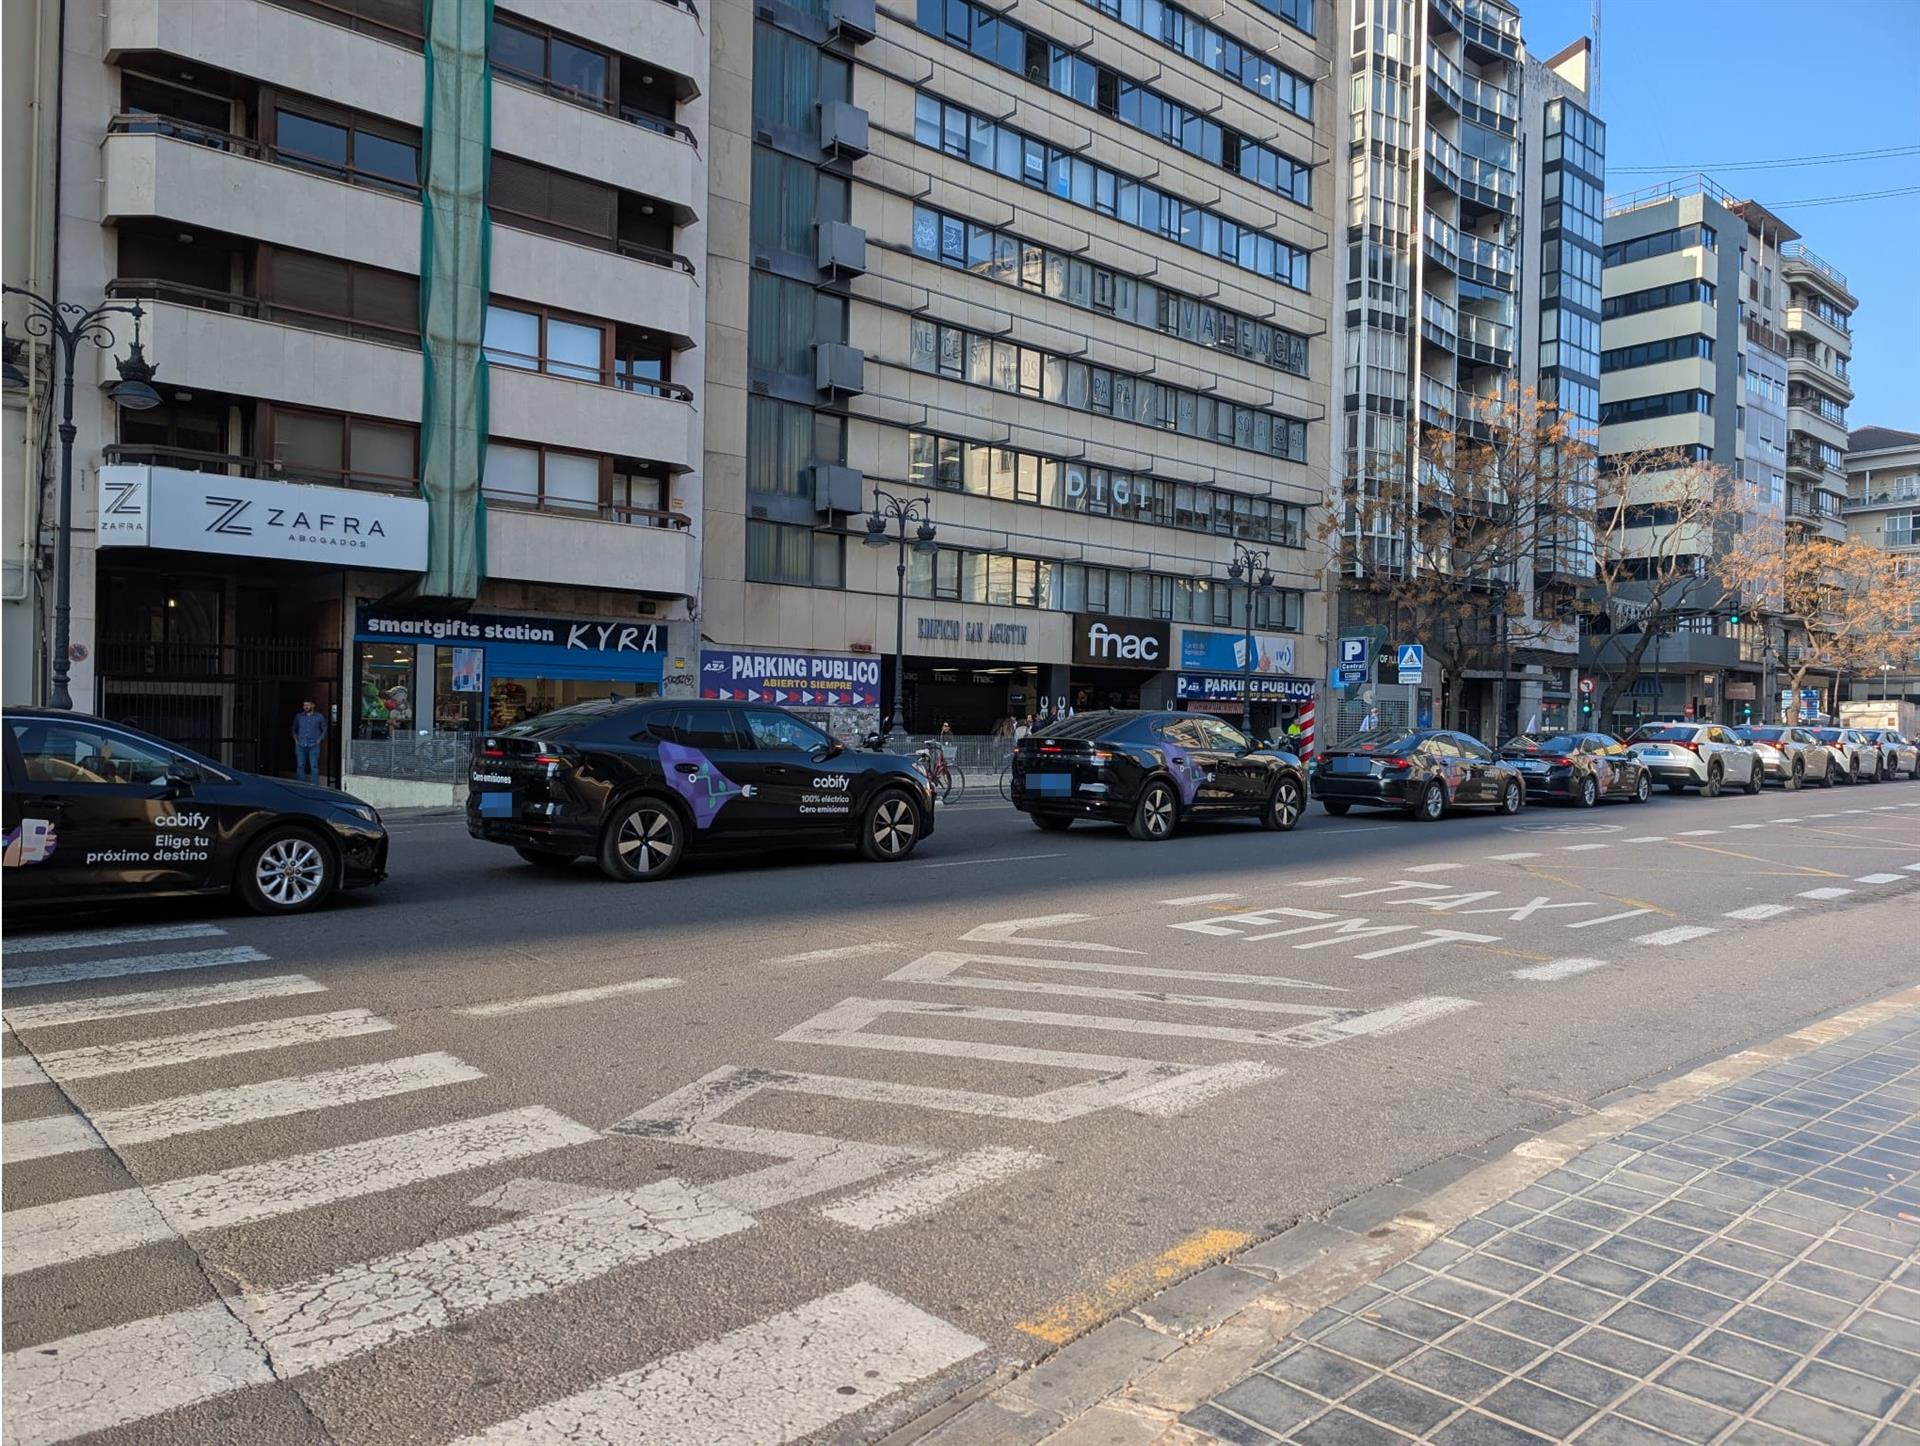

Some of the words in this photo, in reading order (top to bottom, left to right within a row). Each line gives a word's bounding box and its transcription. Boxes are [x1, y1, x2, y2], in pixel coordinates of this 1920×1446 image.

[1184, 302, 1304, 367] VALENCIA
[1095, 377, 1130, 403] PARA
[1181, 401, 1193, 418] LA
[1239, 416, 1303, 448] SOCIEDAD
[1067, 470, 1147, 507] DIGI
[101, 522, 144, 531] ZAFRA
[267, 508, 386, 537] ZAFRA
[288, 534, 367, 548] ABOGADOS
[367, 618, 481, 638] smartgifts
[484, 620, 554, 642] station
[566, 622, 658, 653] KYRA
[917, 618, 960, 641] EDIFICIO
[966, 622, 984, 644] SAN
[989, 624, 1028, 645] AGUSTIN
[1088, 622, 1159, 661] fnac
[732, 655, 806, 680] PARKING
[812, 659, 878, 685] PUBLICO
[934, 671, 957, 682] fnac
[972, 673, 994, 684] fnac
[763, 678, 808, 689] ABIERTO
[810, 680, 852, 690] SIEMPRE
[1205, 678, 1258, 693] PARKIG
[1261, 681, 1311, 697] PUBLICO
[813, 774, 850, 791] cabify
[801, 794, 820, 803] 100%
[821, 794, 850, 803] eléctrico
[800, 805, 816, 813] Cero
[817, 804, 849, 813] emisiones
[154, 812, 210, 830] cabify
[155, 835, 190, 849] Elige
[194, 836, 209, 847] tu
[86, 849, 150, 864] próximo
[153, 849, 208, 861] destino
[1338, 880, 1655, 929] TAXI
[1166, 906, 1504, 960] EMT
